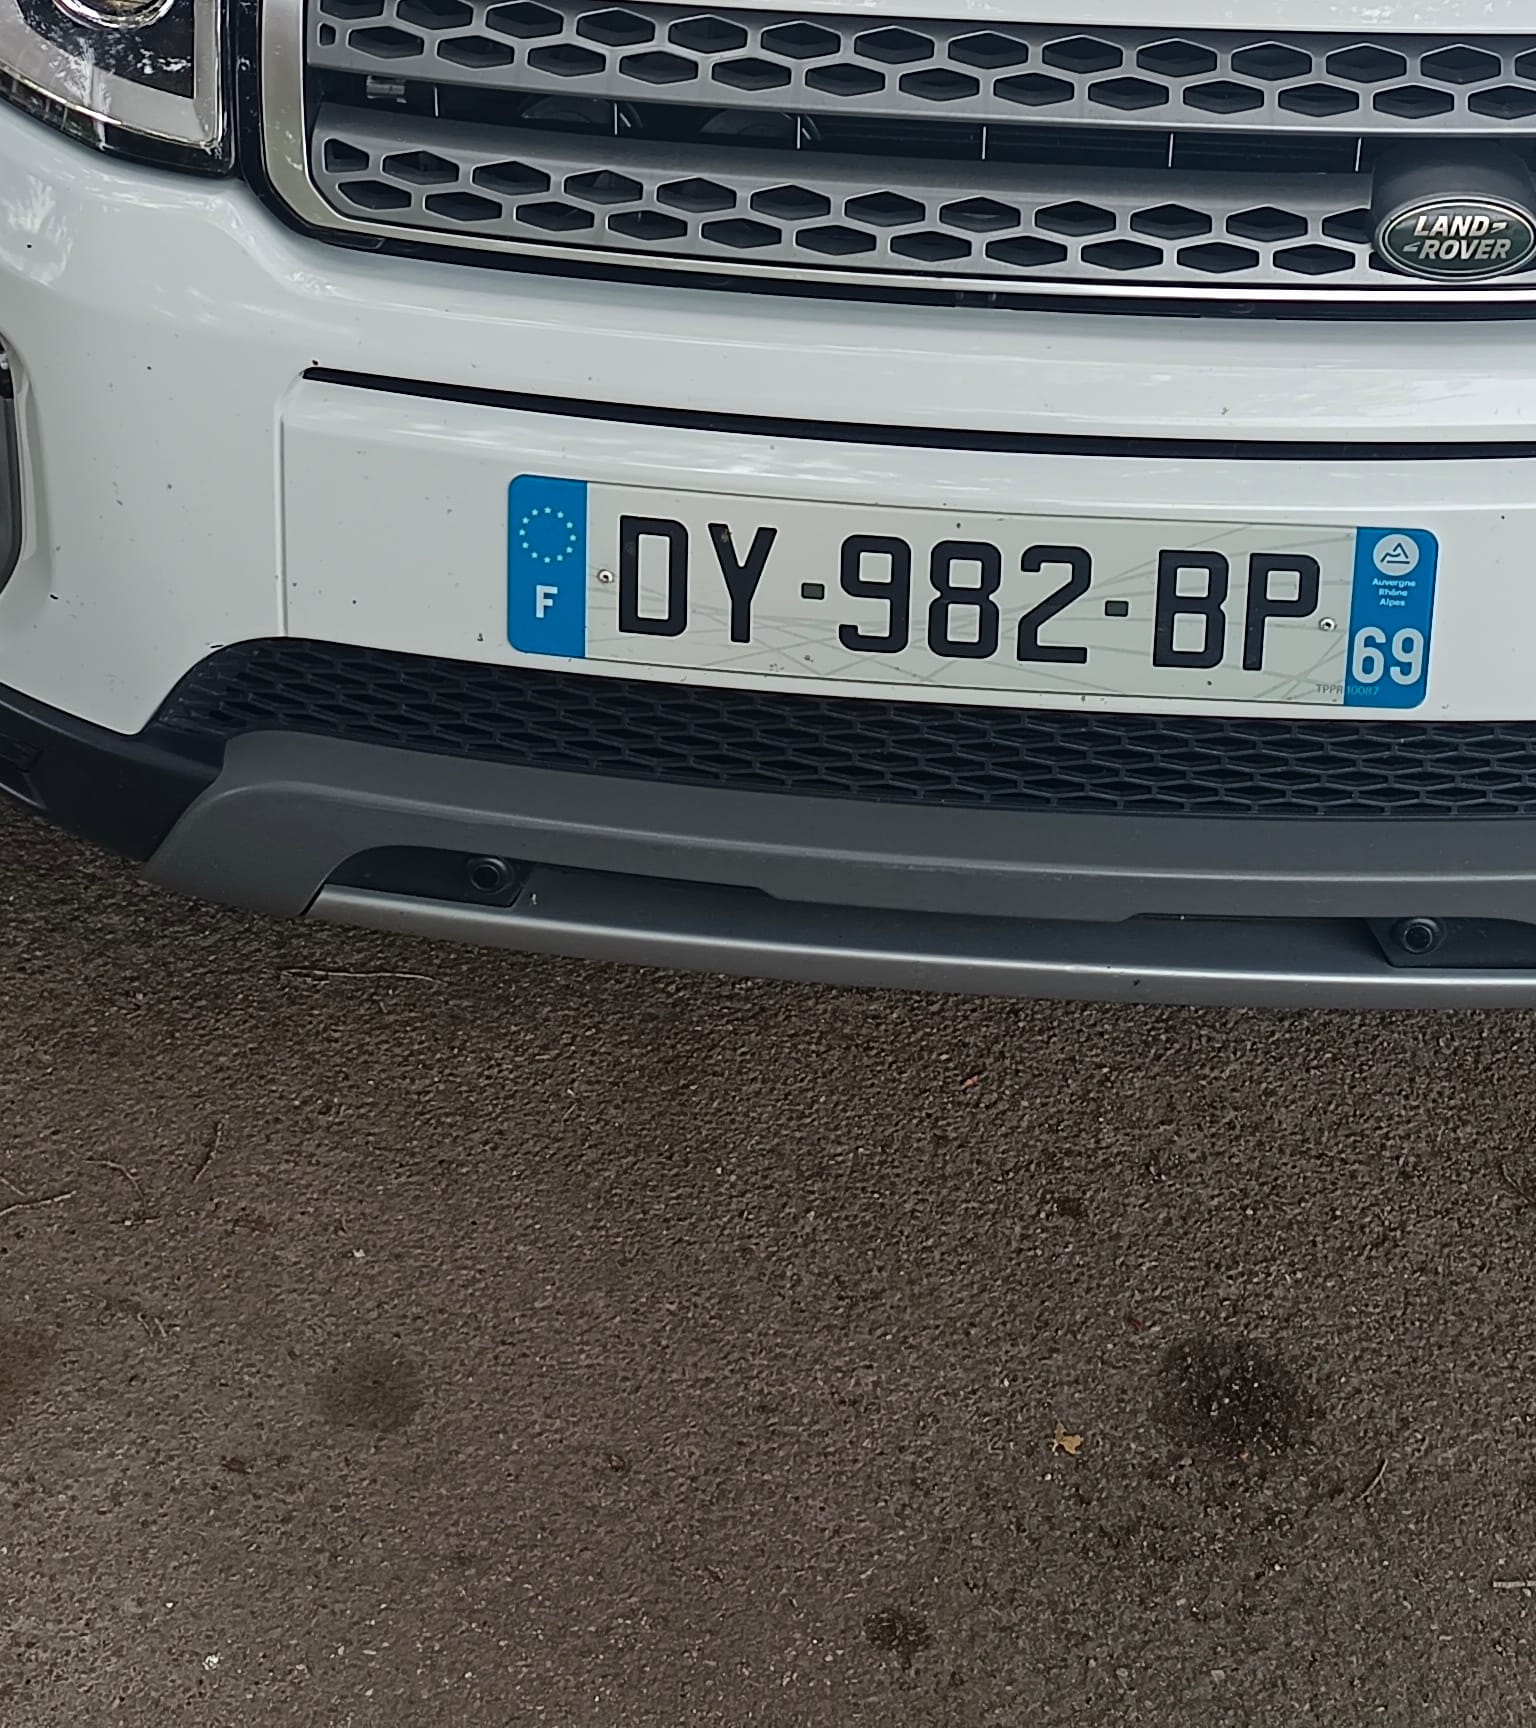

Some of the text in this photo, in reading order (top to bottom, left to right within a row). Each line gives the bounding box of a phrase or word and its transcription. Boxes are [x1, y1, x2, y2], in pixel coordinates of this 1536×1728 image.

[1414, 215, 1490, 237] LAND
[1418, 239, 1511, 260] ROVER
[534, 513, 1322, 673] F DY-982-BP
[1372, 577, 1416, 588] Auvergne
[1378, 587, 1408, 597] Rhône
[1379, 597, 1406, 607] Alpes
[1351, 626, 1425, 685] 69
